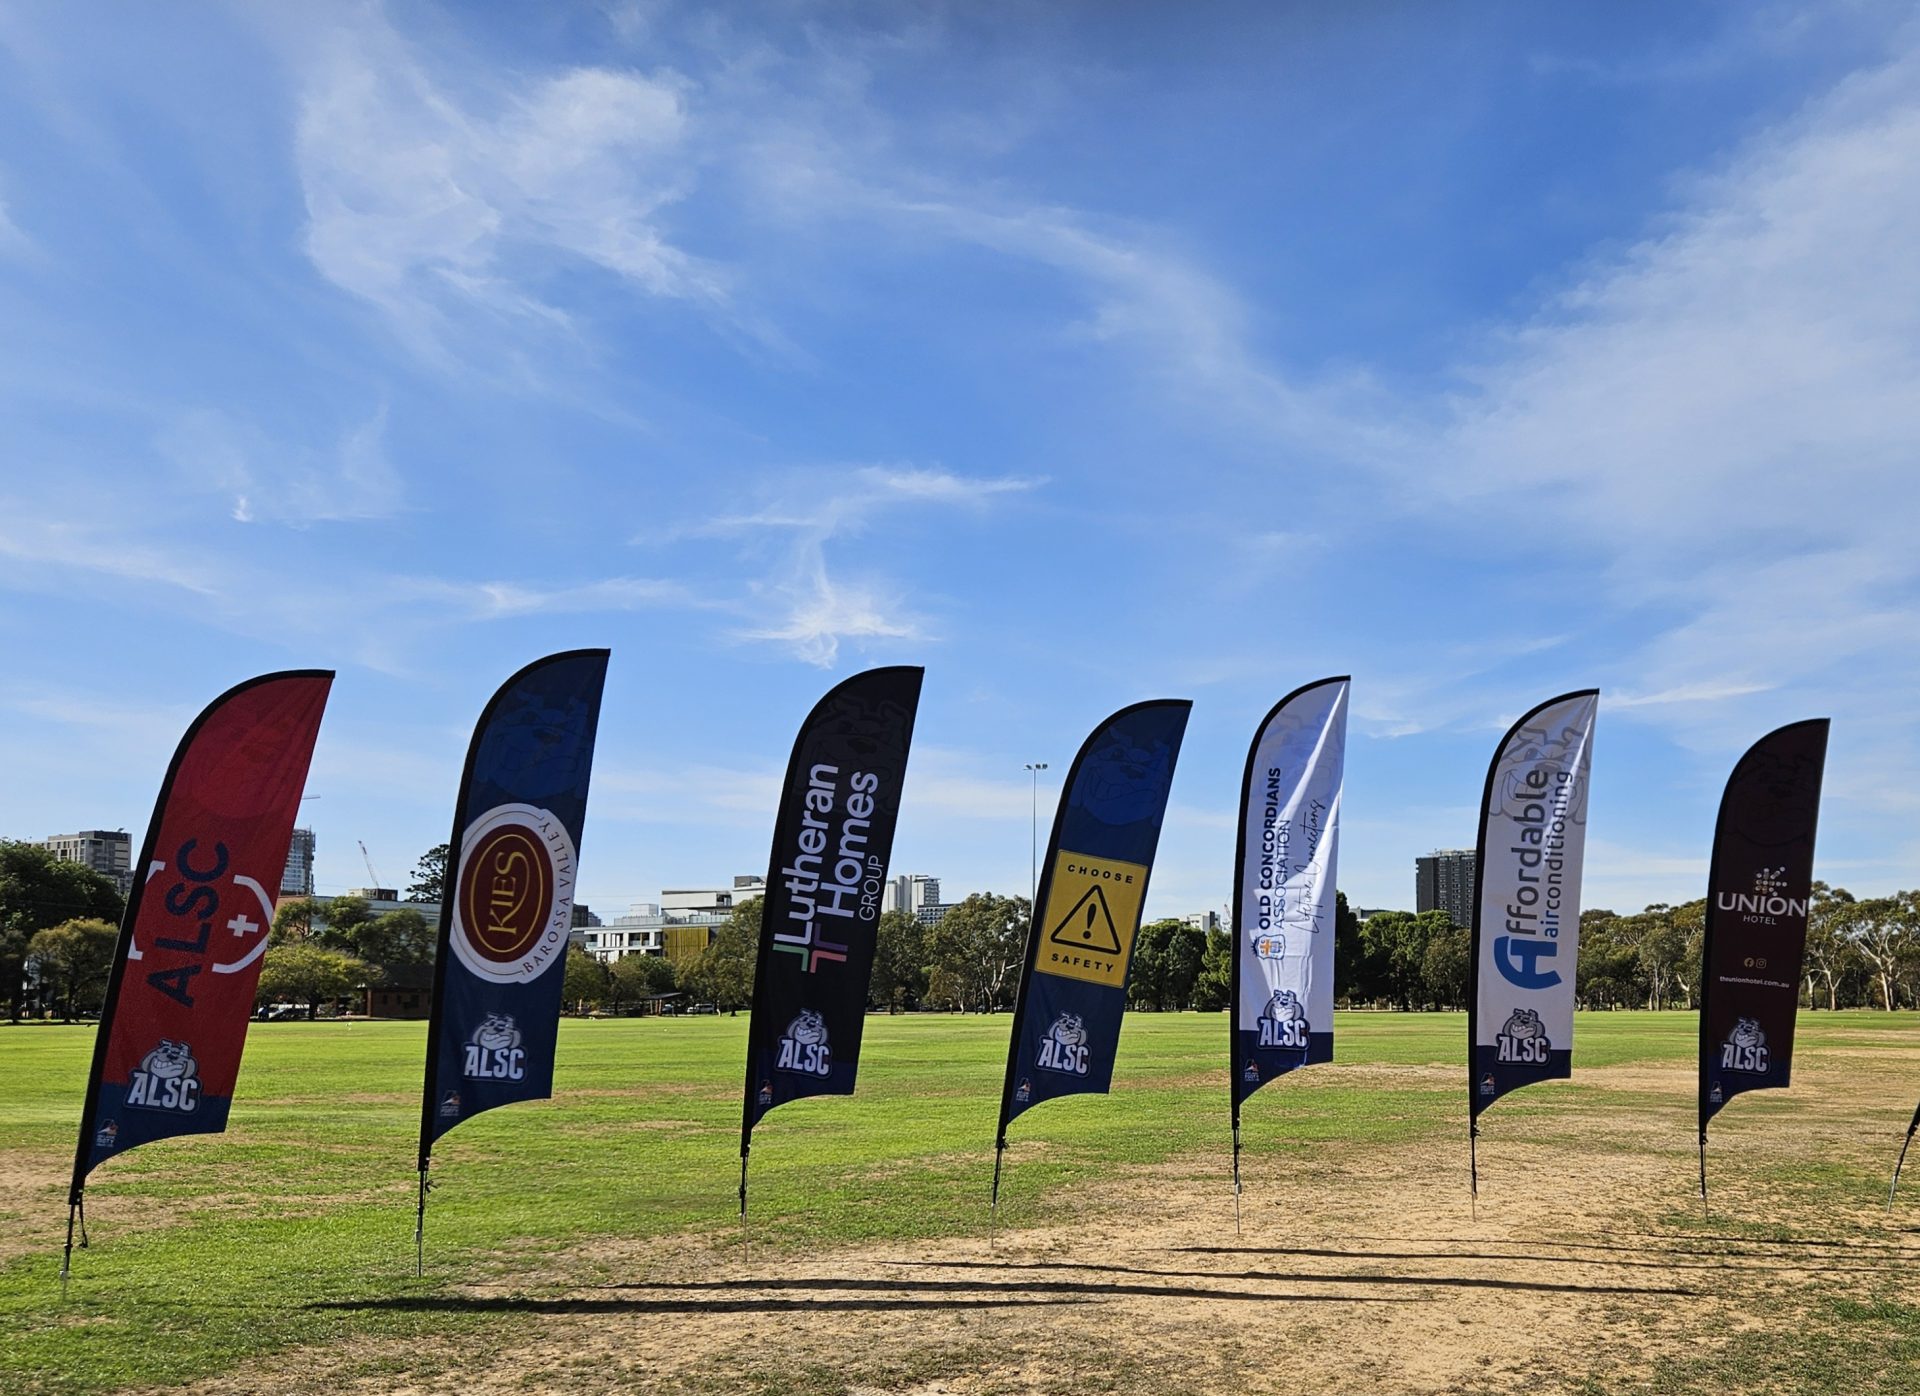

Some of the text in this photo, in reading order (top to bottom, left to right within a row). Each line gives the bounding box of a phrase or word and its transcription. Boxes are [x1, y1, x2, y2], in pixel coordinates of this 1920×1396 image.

[774, 763, 839, 945] Lutheran
[817, 771, 878, 918] Homes
[1259, 767, 1280, 930] OLD CONCORDIANS
[1540, 771, 1573, 938] airconditioning
[488, 851, 530, 936] KIES
[859, 855, 884, 921] GROUP
[1067, 864, 1134, 884] CHOOSE
[1273, 820, 1291, 930] ASSOCIATION
[1494, 769, 1562, 989] Affordable
[523, 822, 572, 973] BAROSSA VALLEY
[1717, 891, 1807, 917] UNION
[146, 838, 229, 1009] ALSC
[1743, 914, 1777, 926] HOTEL
[1051, 953, 1114, 973] SAFETY
[1259, 1019, 1307, 1047] ALSC
[1498, 1036, 1547, 1063] ALSC
[463, 1045, 525, 1080] ALSC
[778, 1039, 830, 1074] ALSC
[1037, 1039, 1089, 1073] ALSC
[1722, 1044, 1767, 1072] ALSC
[128, 1071, 198, 1111] ALSC
